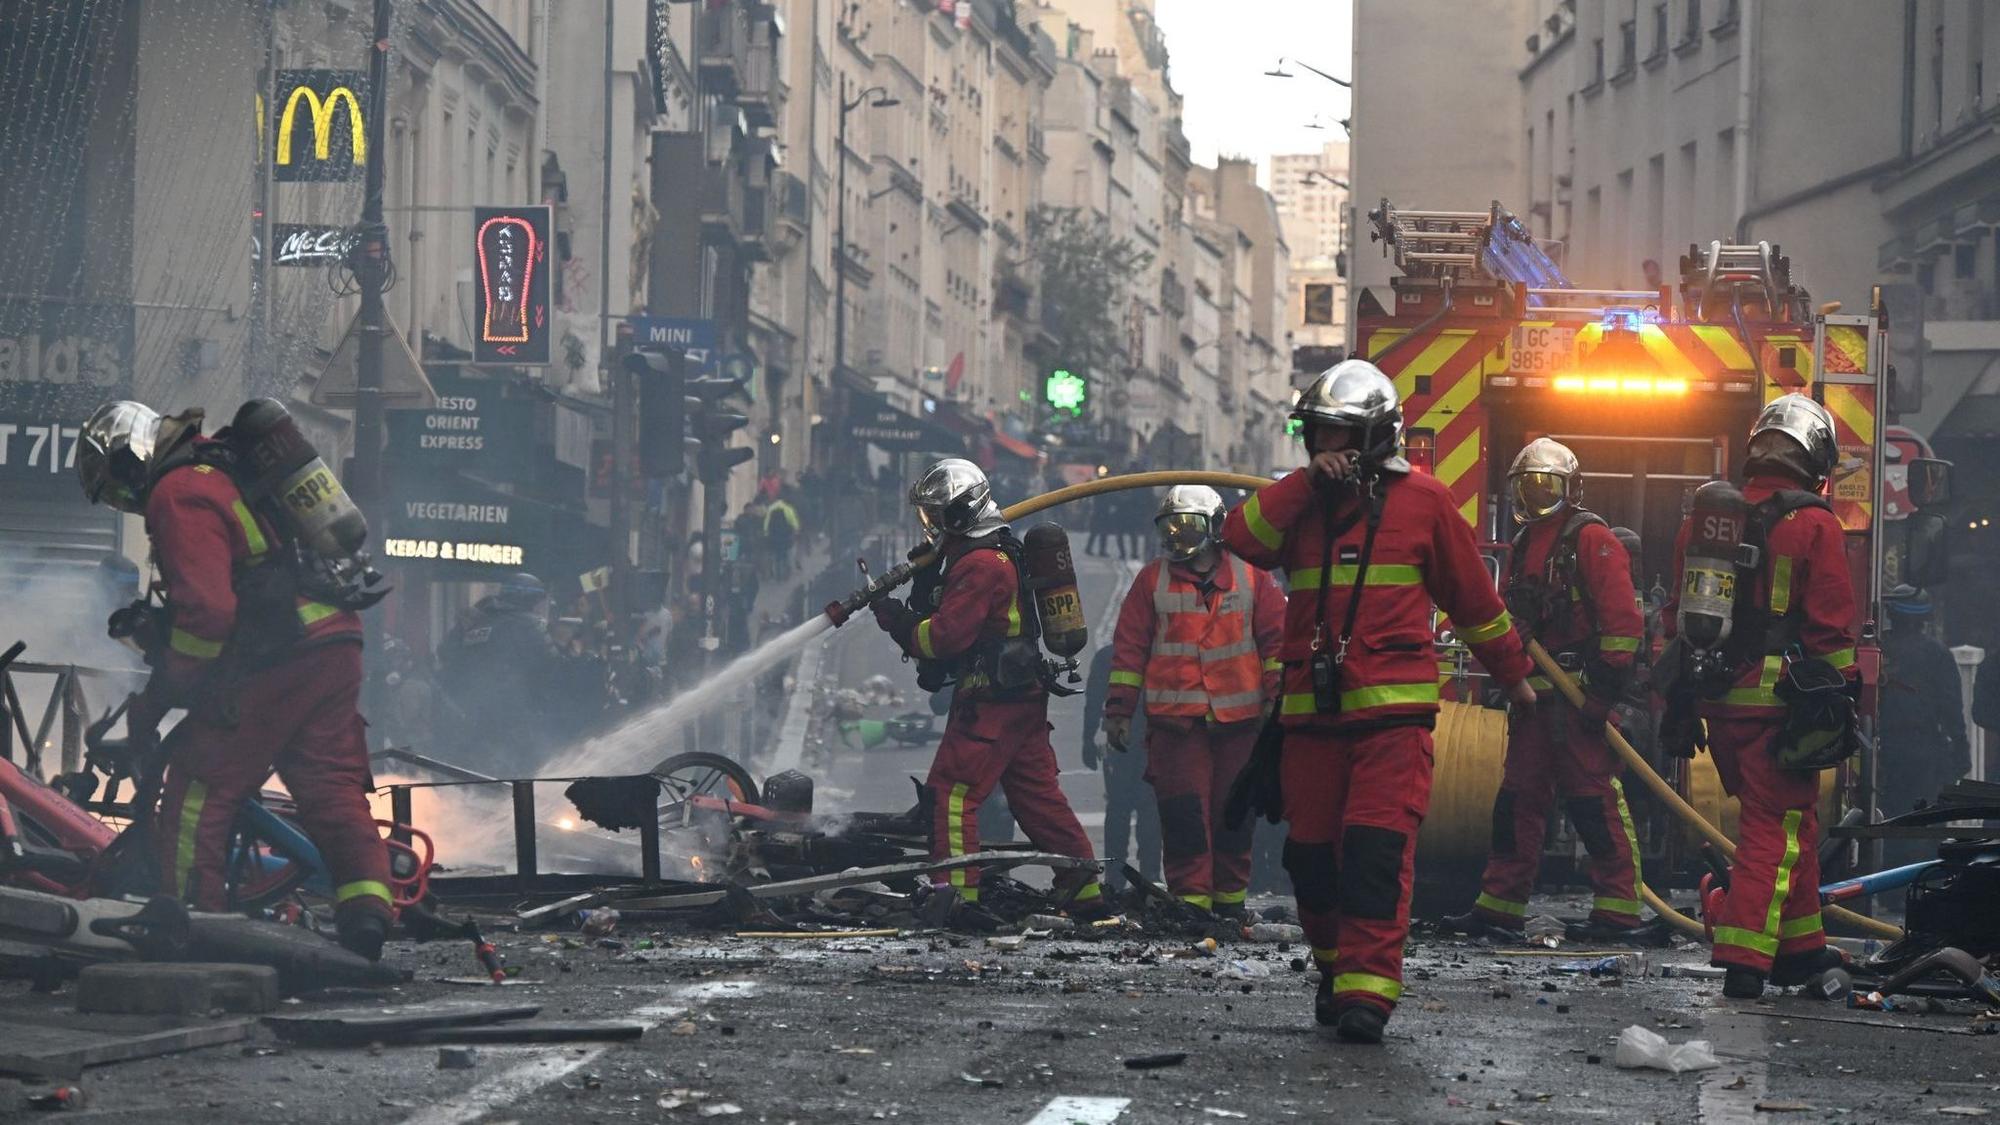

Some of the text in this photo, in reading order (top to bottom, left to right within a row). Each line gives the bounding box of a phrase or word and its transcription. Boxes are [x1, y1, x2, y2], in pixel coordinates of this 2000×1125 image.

[650, 327, 692, 343] MINI
[425, 415, 481, 430] ORIENT
[420, 434, 484, 450] EXPRESS
[406, 502, 510, 523] VEGETARIEN
[385, 538, 523, 566] KEBAB & BURGER
